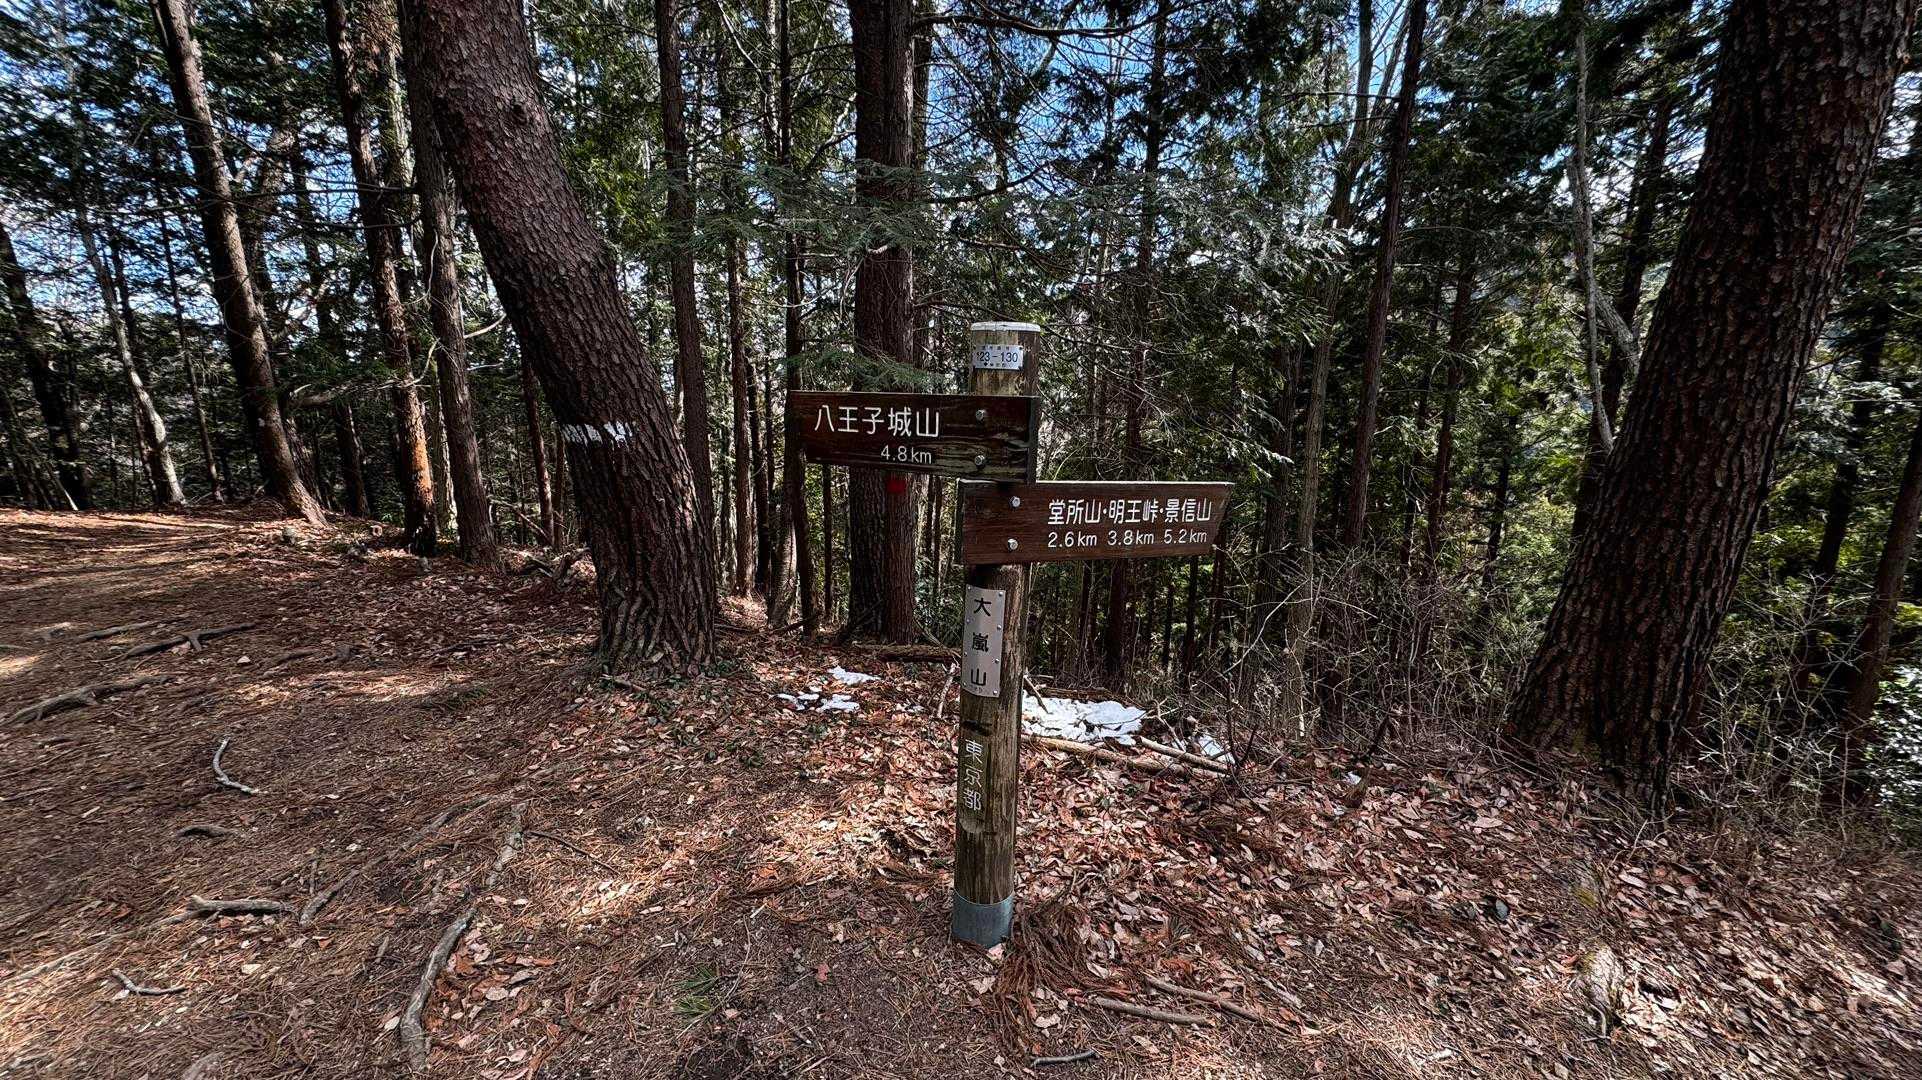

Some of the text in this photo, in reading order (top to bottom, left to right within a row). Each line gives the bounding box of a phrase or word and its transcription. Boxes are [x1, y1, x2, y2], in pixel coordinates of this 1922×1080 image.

[814, 404, 939, 437] 八王子城山
[971, 597, 992, 686] 大嵐山
[963, 739, 984, 811] 東京都
